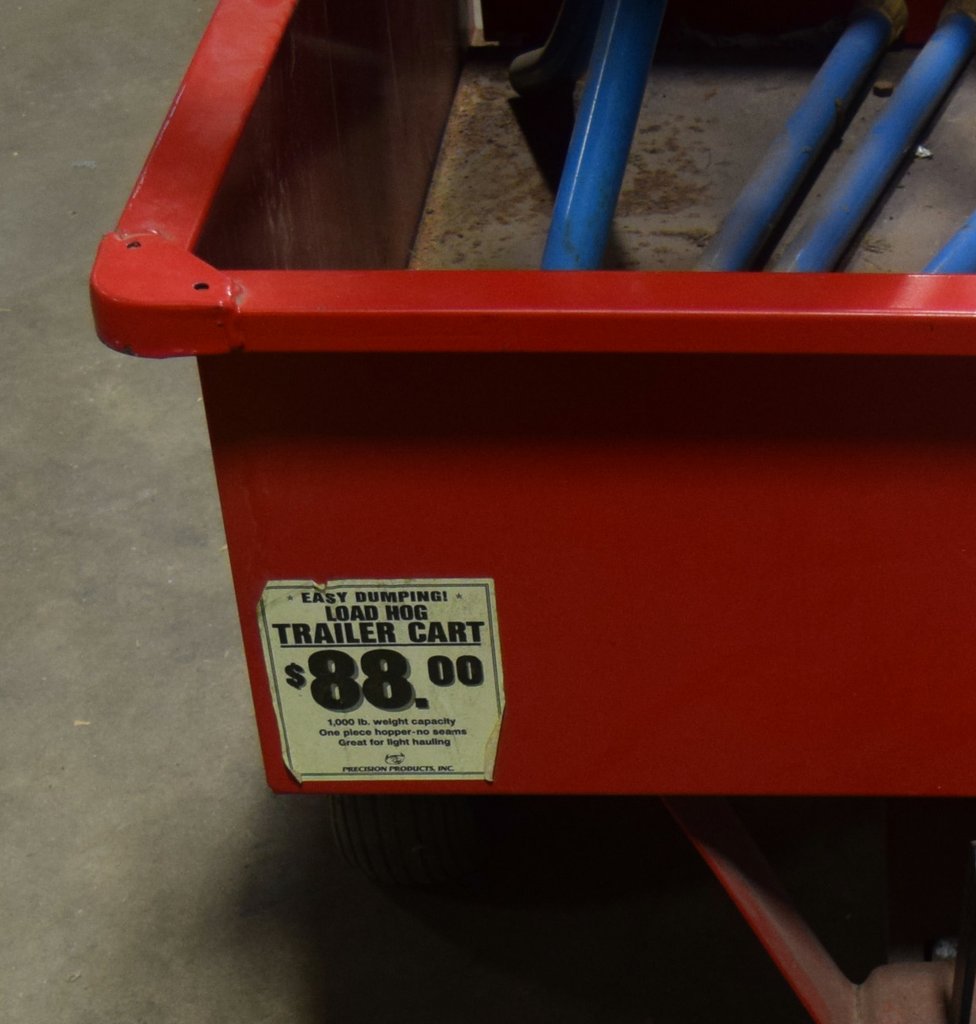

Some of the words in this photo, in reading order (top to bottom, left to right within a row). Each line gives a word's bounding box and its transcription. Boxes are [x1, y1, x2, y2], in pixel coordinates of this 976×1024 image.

[301, 592, 347, 604] EASY
[356, 591, 448, 602] DUMPING!
[325, 605, 378, 621] LOAD
[385, 605, 428, 620] HOG
[272, 622, 396, 644] TRAILER
[408, 622, 484, 643] CART
[328, 718, 354, 726] 1,000
[373, 718, 408, 726] weight
[412, 718, 456, 727] capacity
[343, 728, 372, 737] piece
[387, 738, 409, 746] light
[412, 738, 450, 746] hauling
